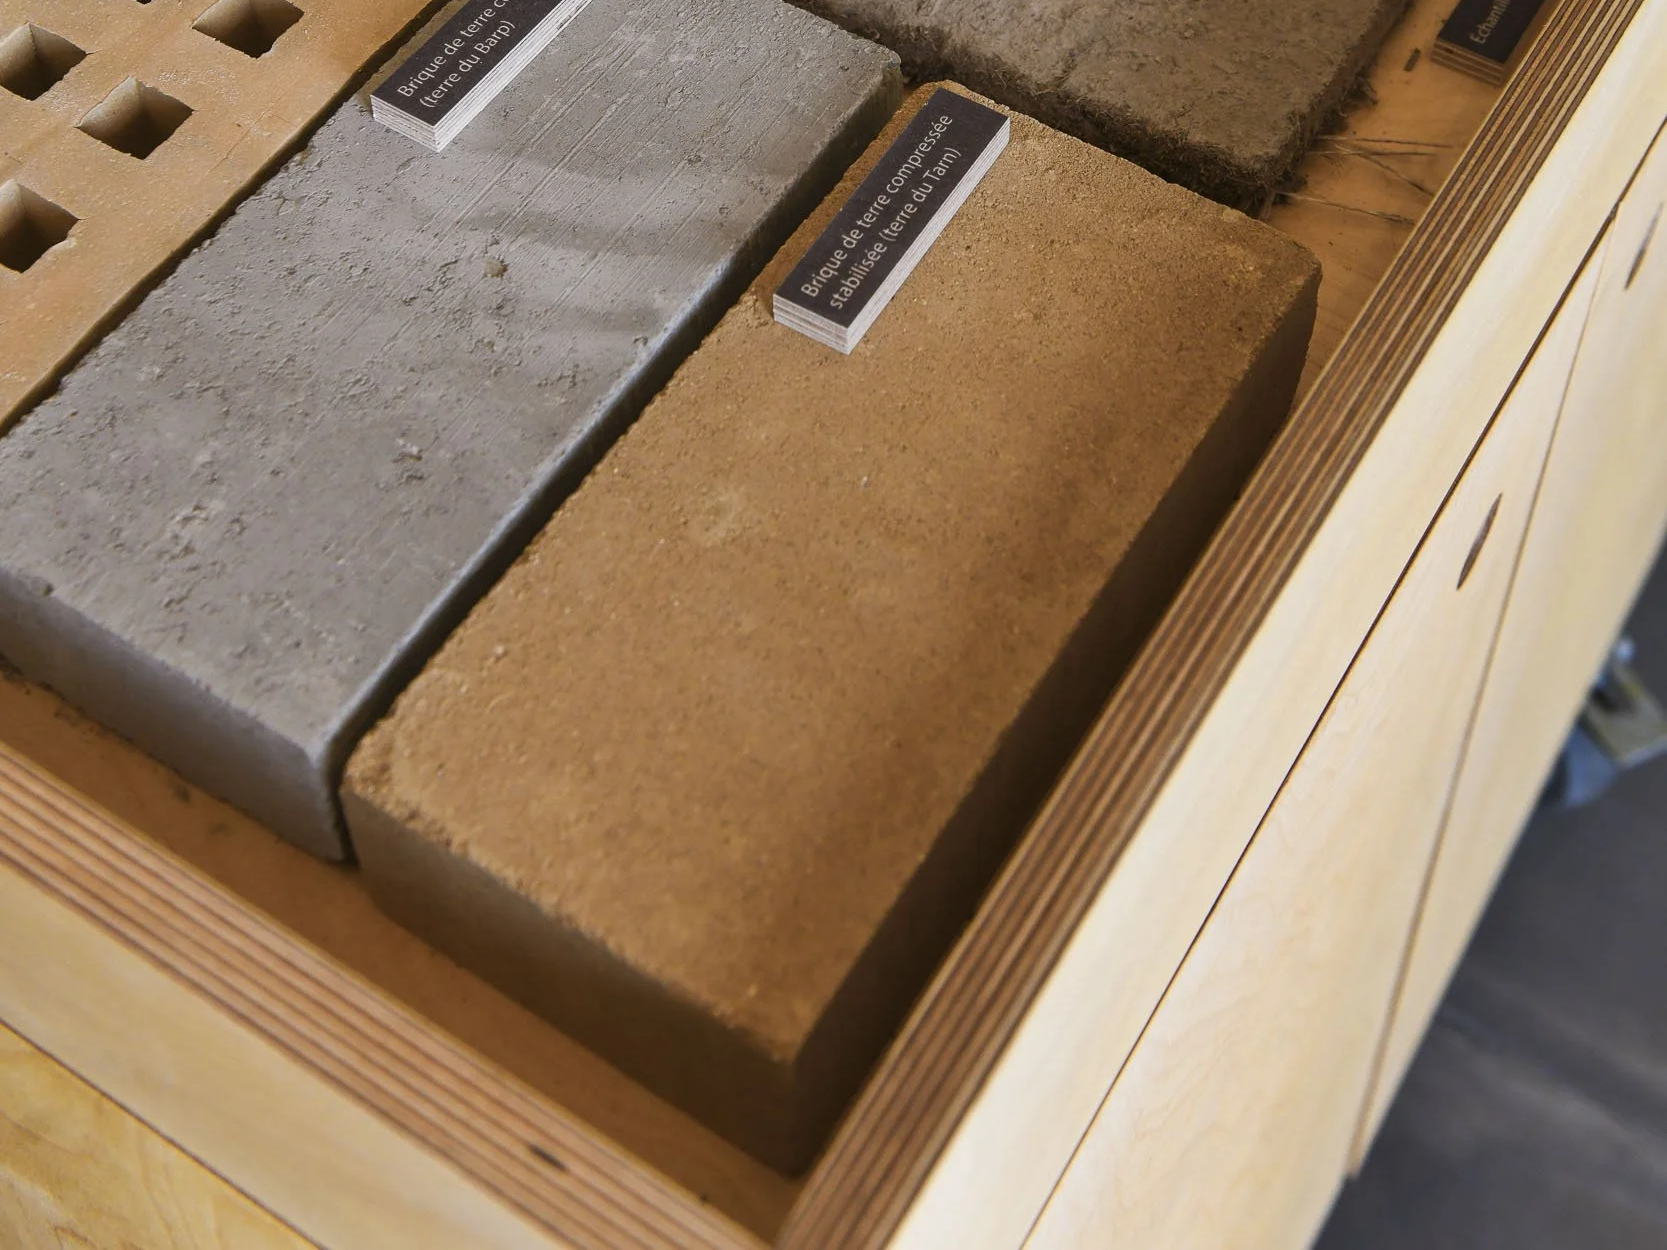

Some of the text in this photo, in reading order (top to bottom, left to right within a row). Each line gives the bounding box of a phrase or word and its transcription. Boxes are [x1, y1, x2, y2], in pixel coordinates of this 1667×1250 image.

[397, 55, 447, 98] Brique
[444, 38, 464, 57] de
[459, 7, 497, 40] terre
[419, 19, 516, 109] (terre du Barp)
[800, 114, 953, 298] Brique de terre compressée
[829, 146, 963, 310] stabilisée (terre du Tarn)
